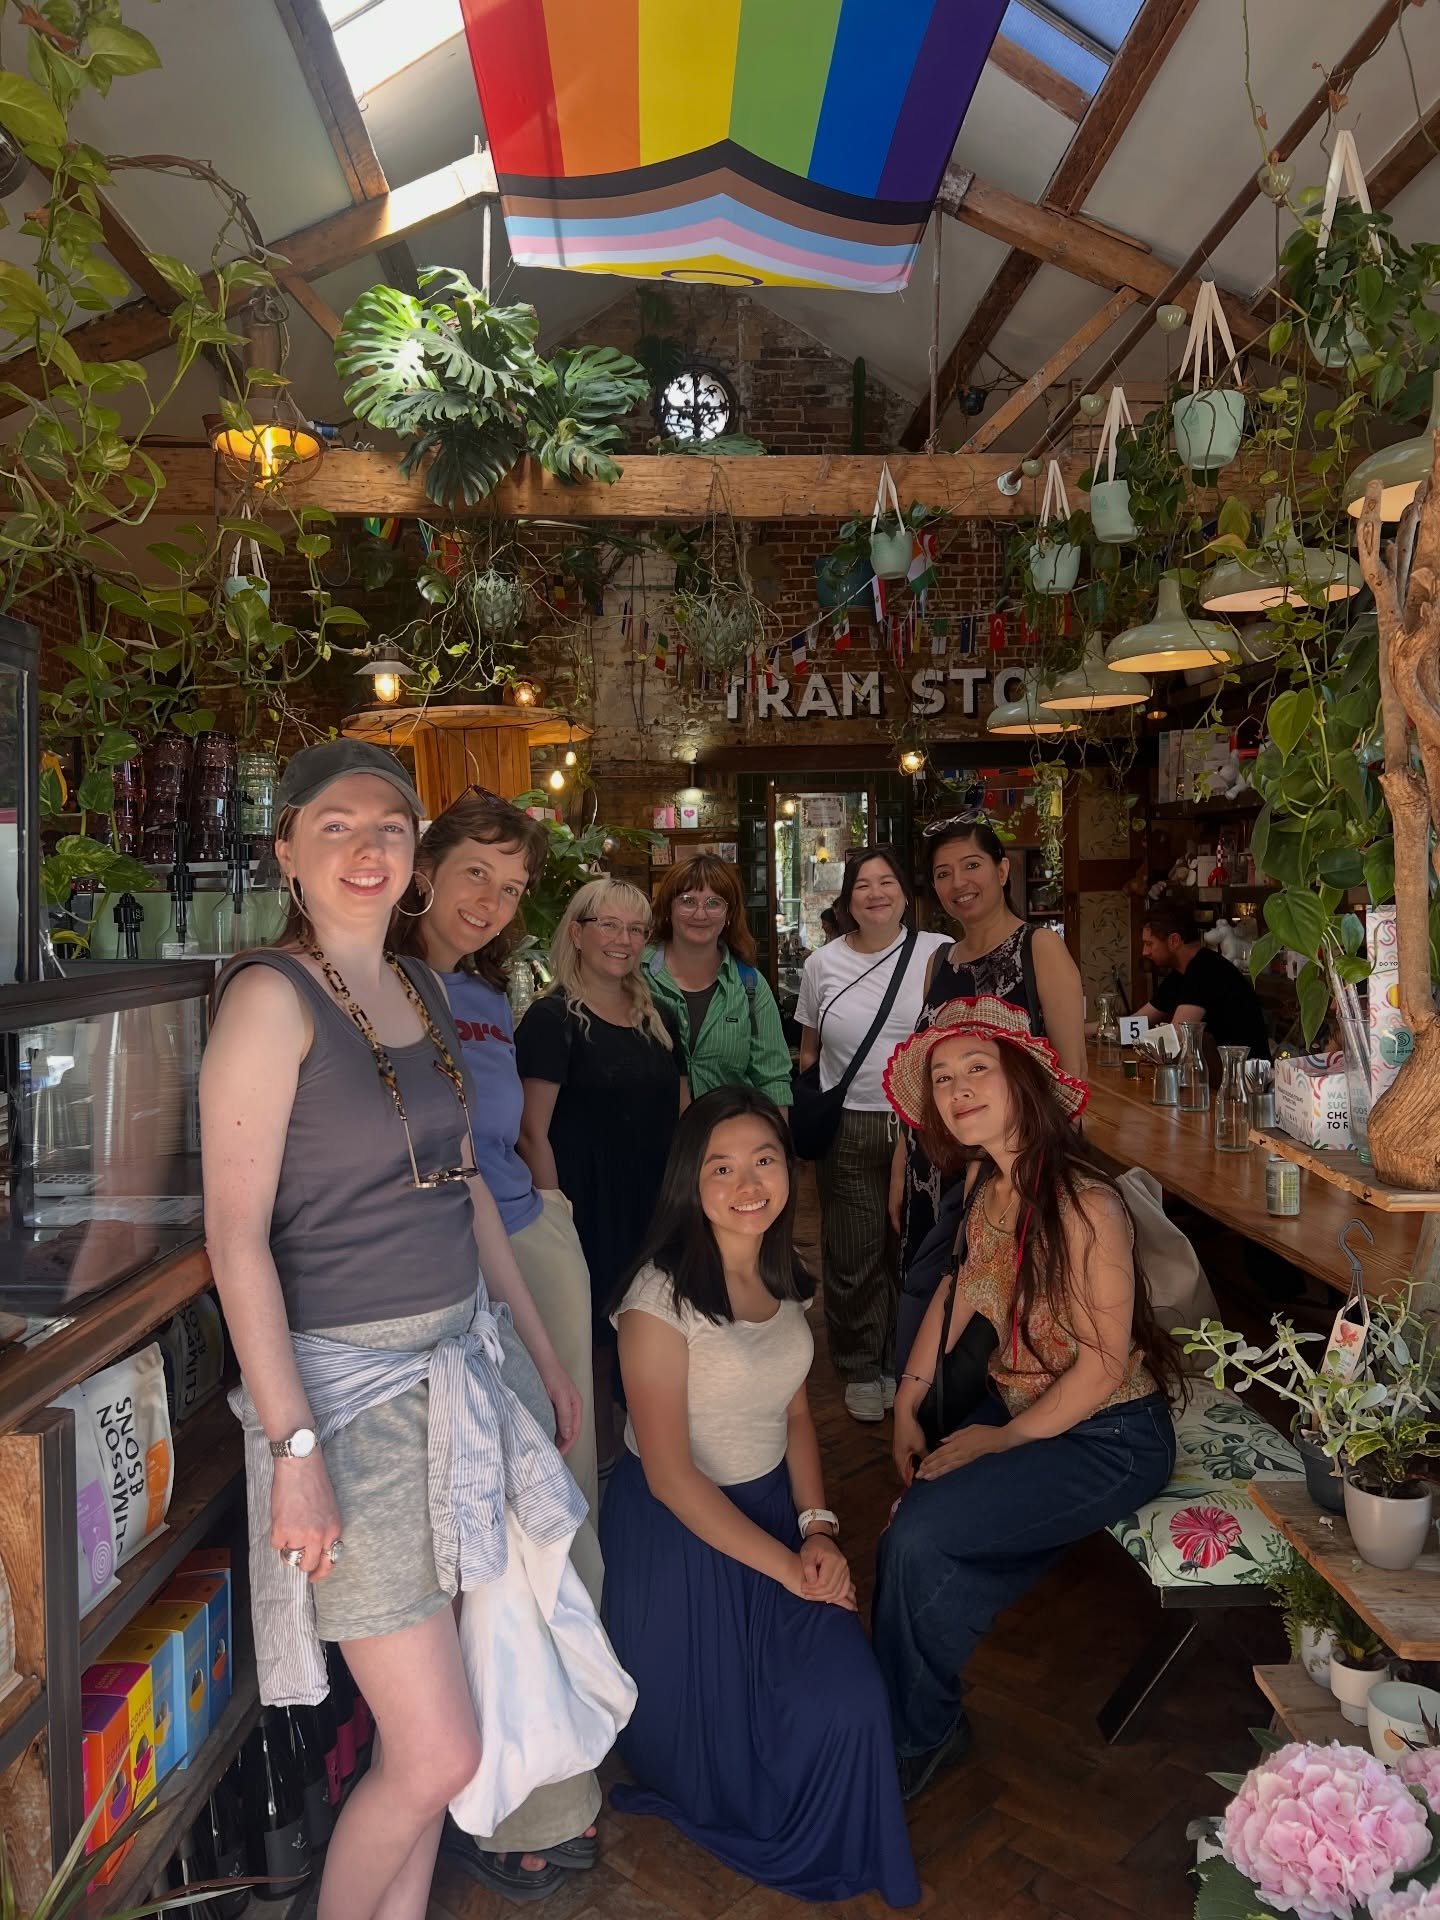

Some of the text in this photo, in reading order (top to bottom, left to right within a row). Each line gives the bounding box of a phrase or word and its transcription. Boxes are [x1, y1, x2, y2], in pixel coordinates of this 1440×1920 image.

[725, 671, 882, 719] TRAM
[1129, 1021, 1140, 1039] 5
[1327, 1121, 1341, 1130] TO
